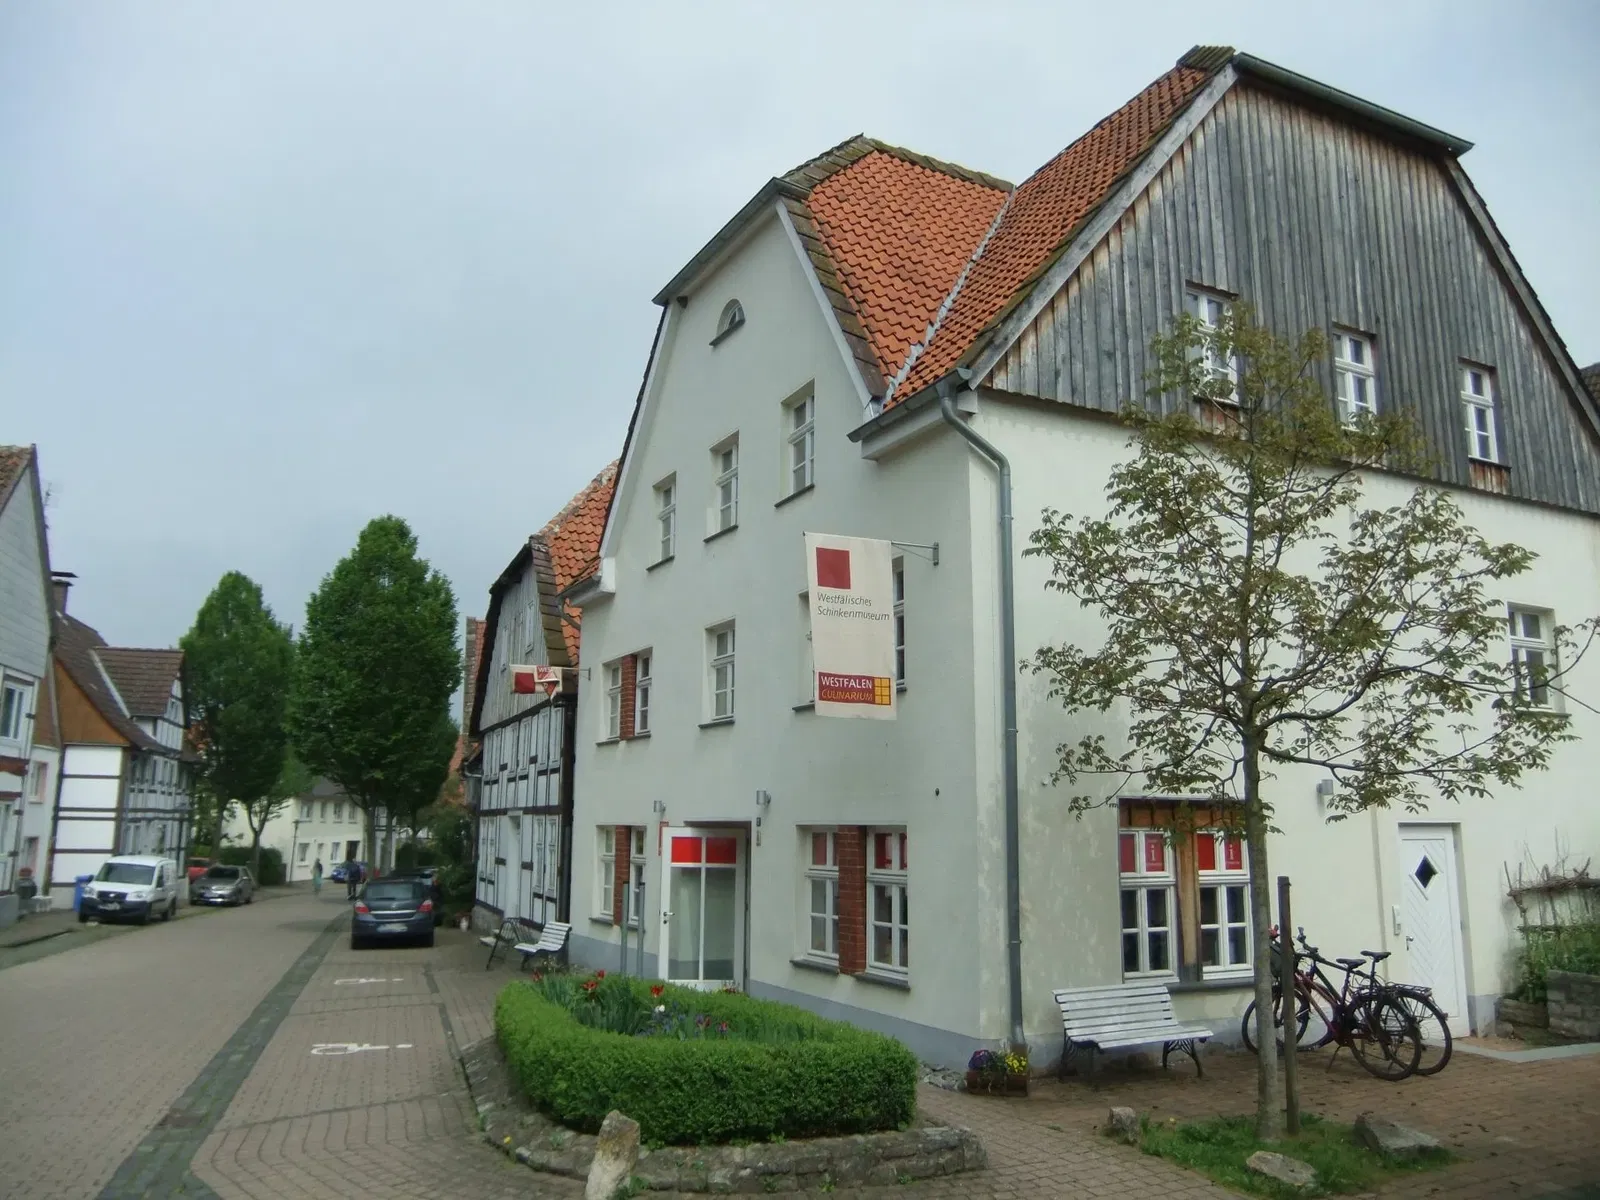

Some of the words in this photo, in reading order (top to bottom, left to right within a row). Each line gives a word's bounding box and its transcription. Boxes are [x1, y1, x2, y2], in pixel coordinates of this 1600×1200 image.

[817, 592, 872, 606] Westfälisches
[817, 605, 890, 620] Schinkenmuseum
[821, 675, 872, 689] WESTFALEN
[821, 688, 873, 701] CULINARIUM
